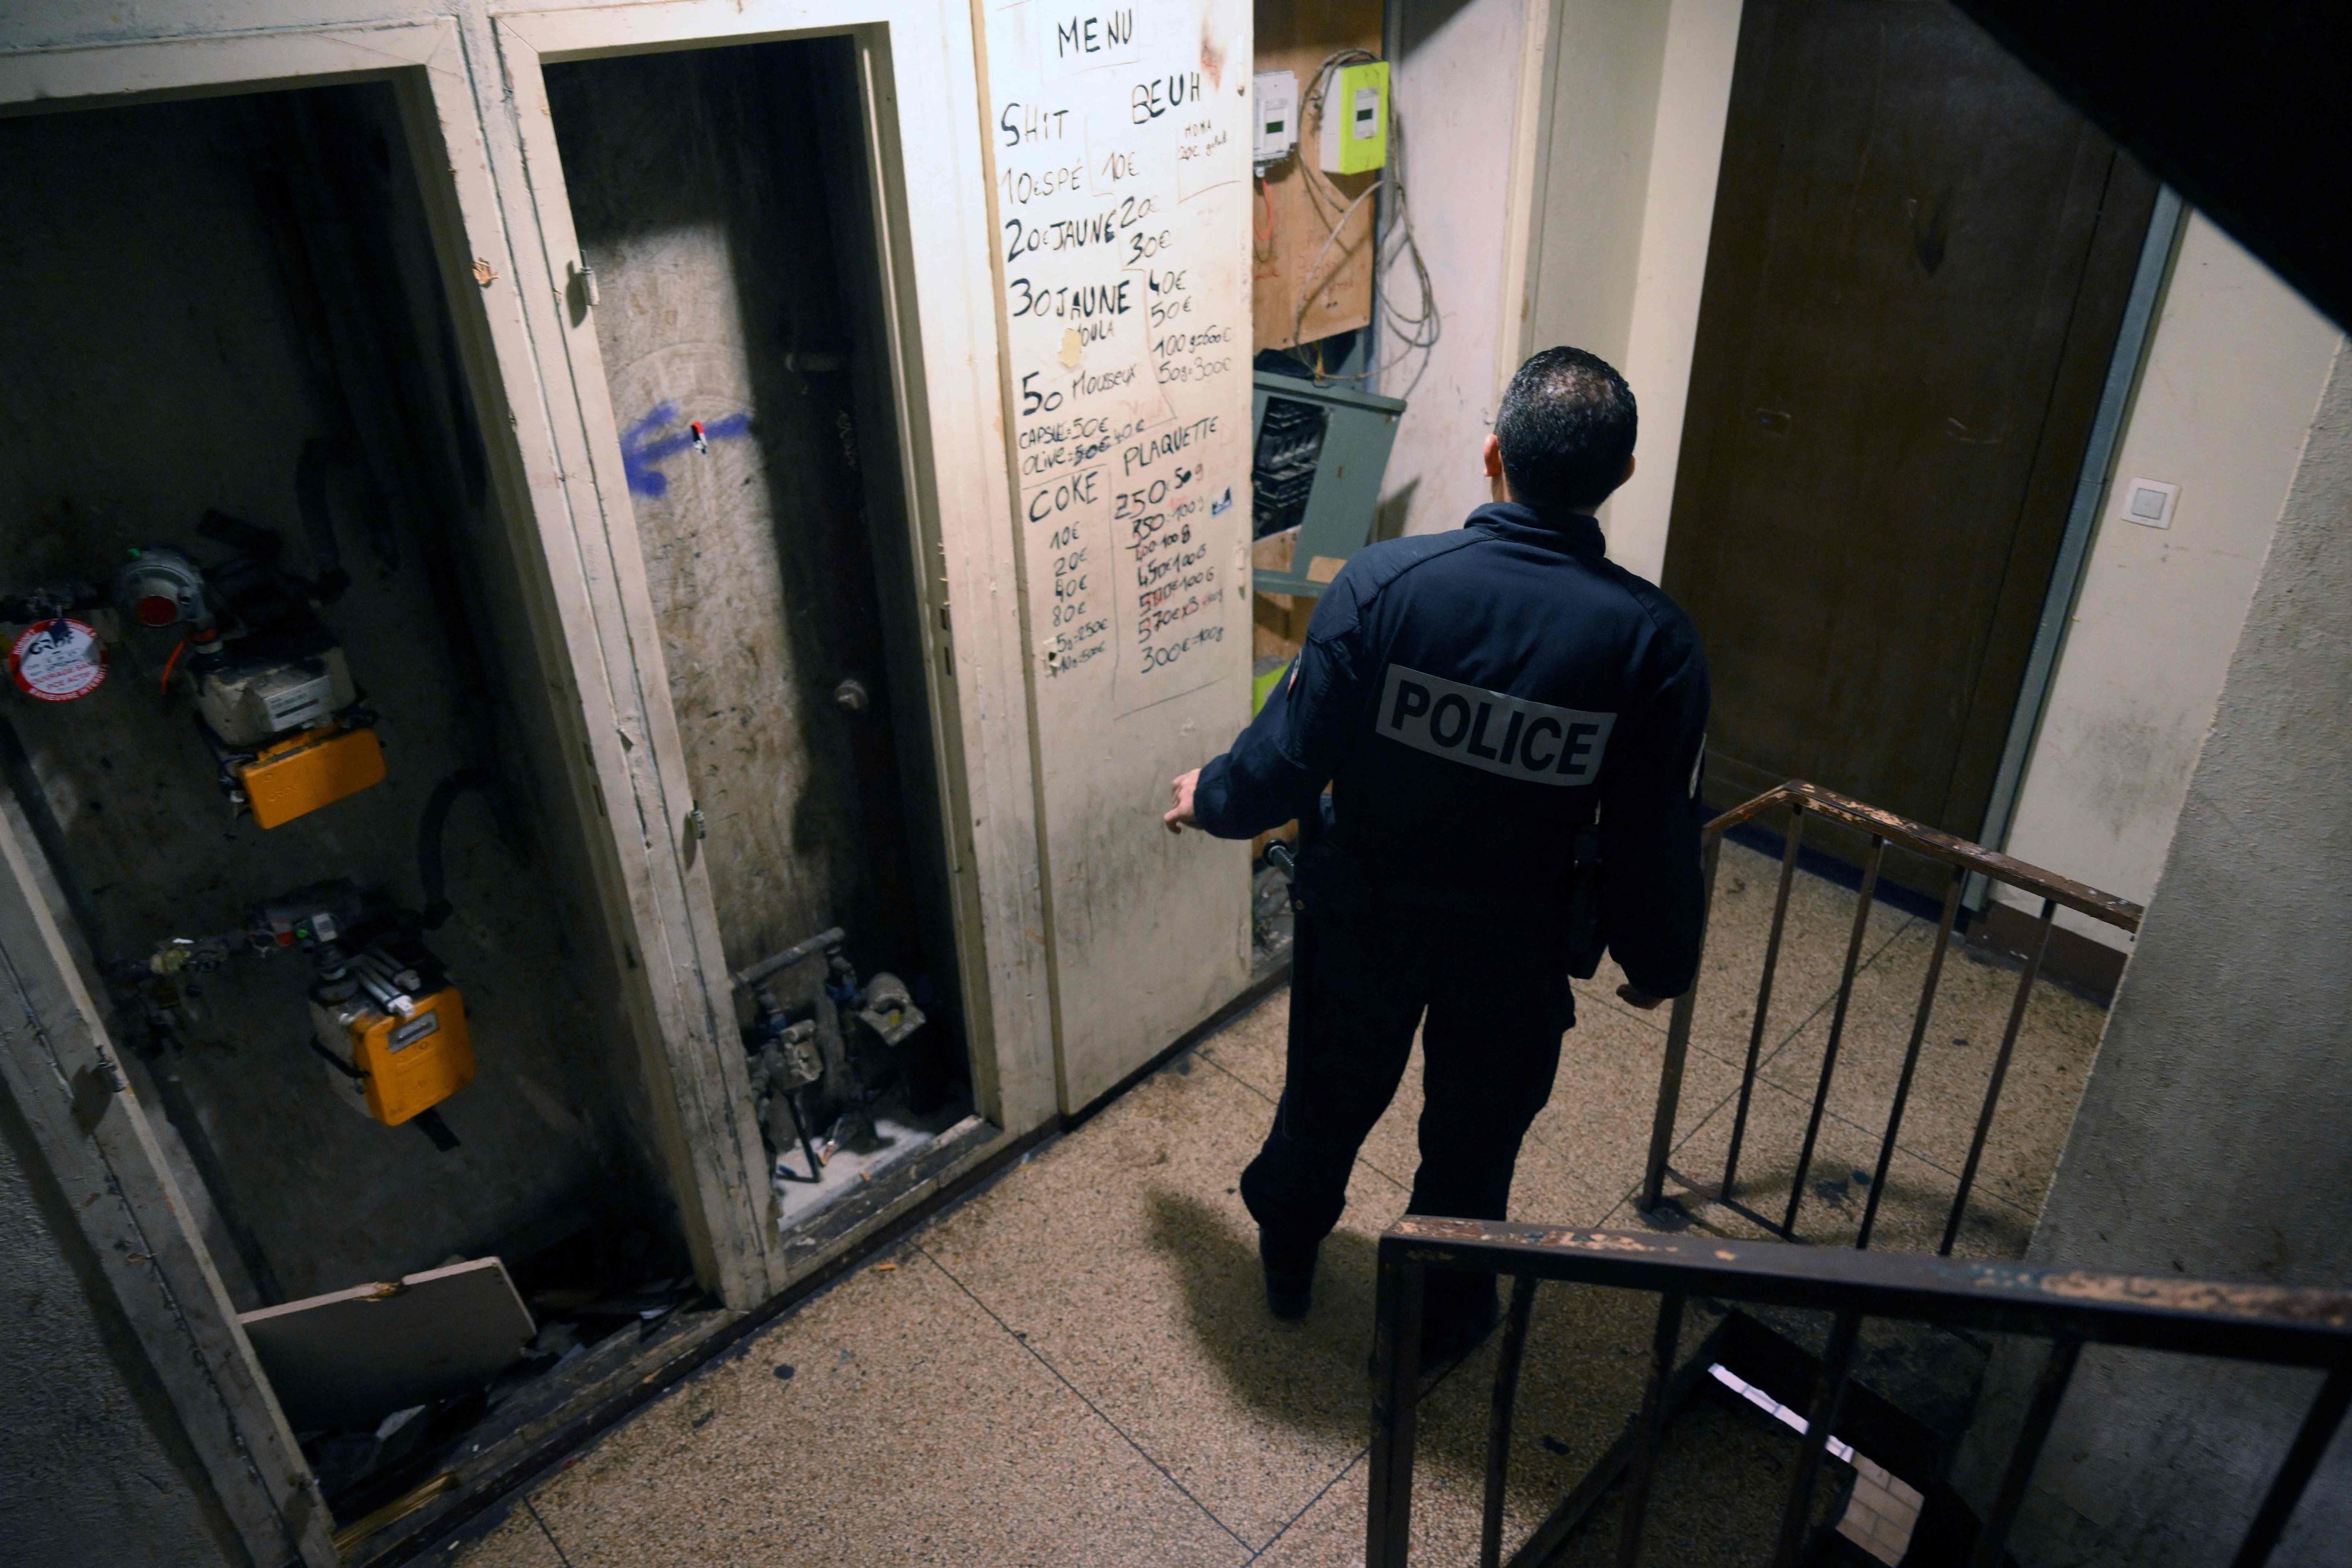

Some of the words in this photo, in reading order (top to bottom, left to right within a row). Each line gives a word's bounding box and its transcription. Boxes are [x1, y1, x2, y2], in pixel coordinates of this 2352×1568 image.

[1058, 9, 1132, 58] MENU
[1132, 72, 1200, 124] BEUH
[1001, 102, 1069, 147] SHIT
[1102, 151, 1140, 183] 10€
[1127, 229, 1172, 266] 30€
[1148, 269, 1187, 296] 40€
[1151, 295, 1192, 329] 50€
[1022, 370, 1063, 416] 50
[1124, 415, 1219, 477] PLAQUETTE
[1029, 470, 1098, 523] COKE
[1050, 520, 1080, 550] 10€
[1054, 547, 1087, 577] 20€
[1053, 601, 1087, 627] 80€
[1390, 678, 1599, 775] POLICE
